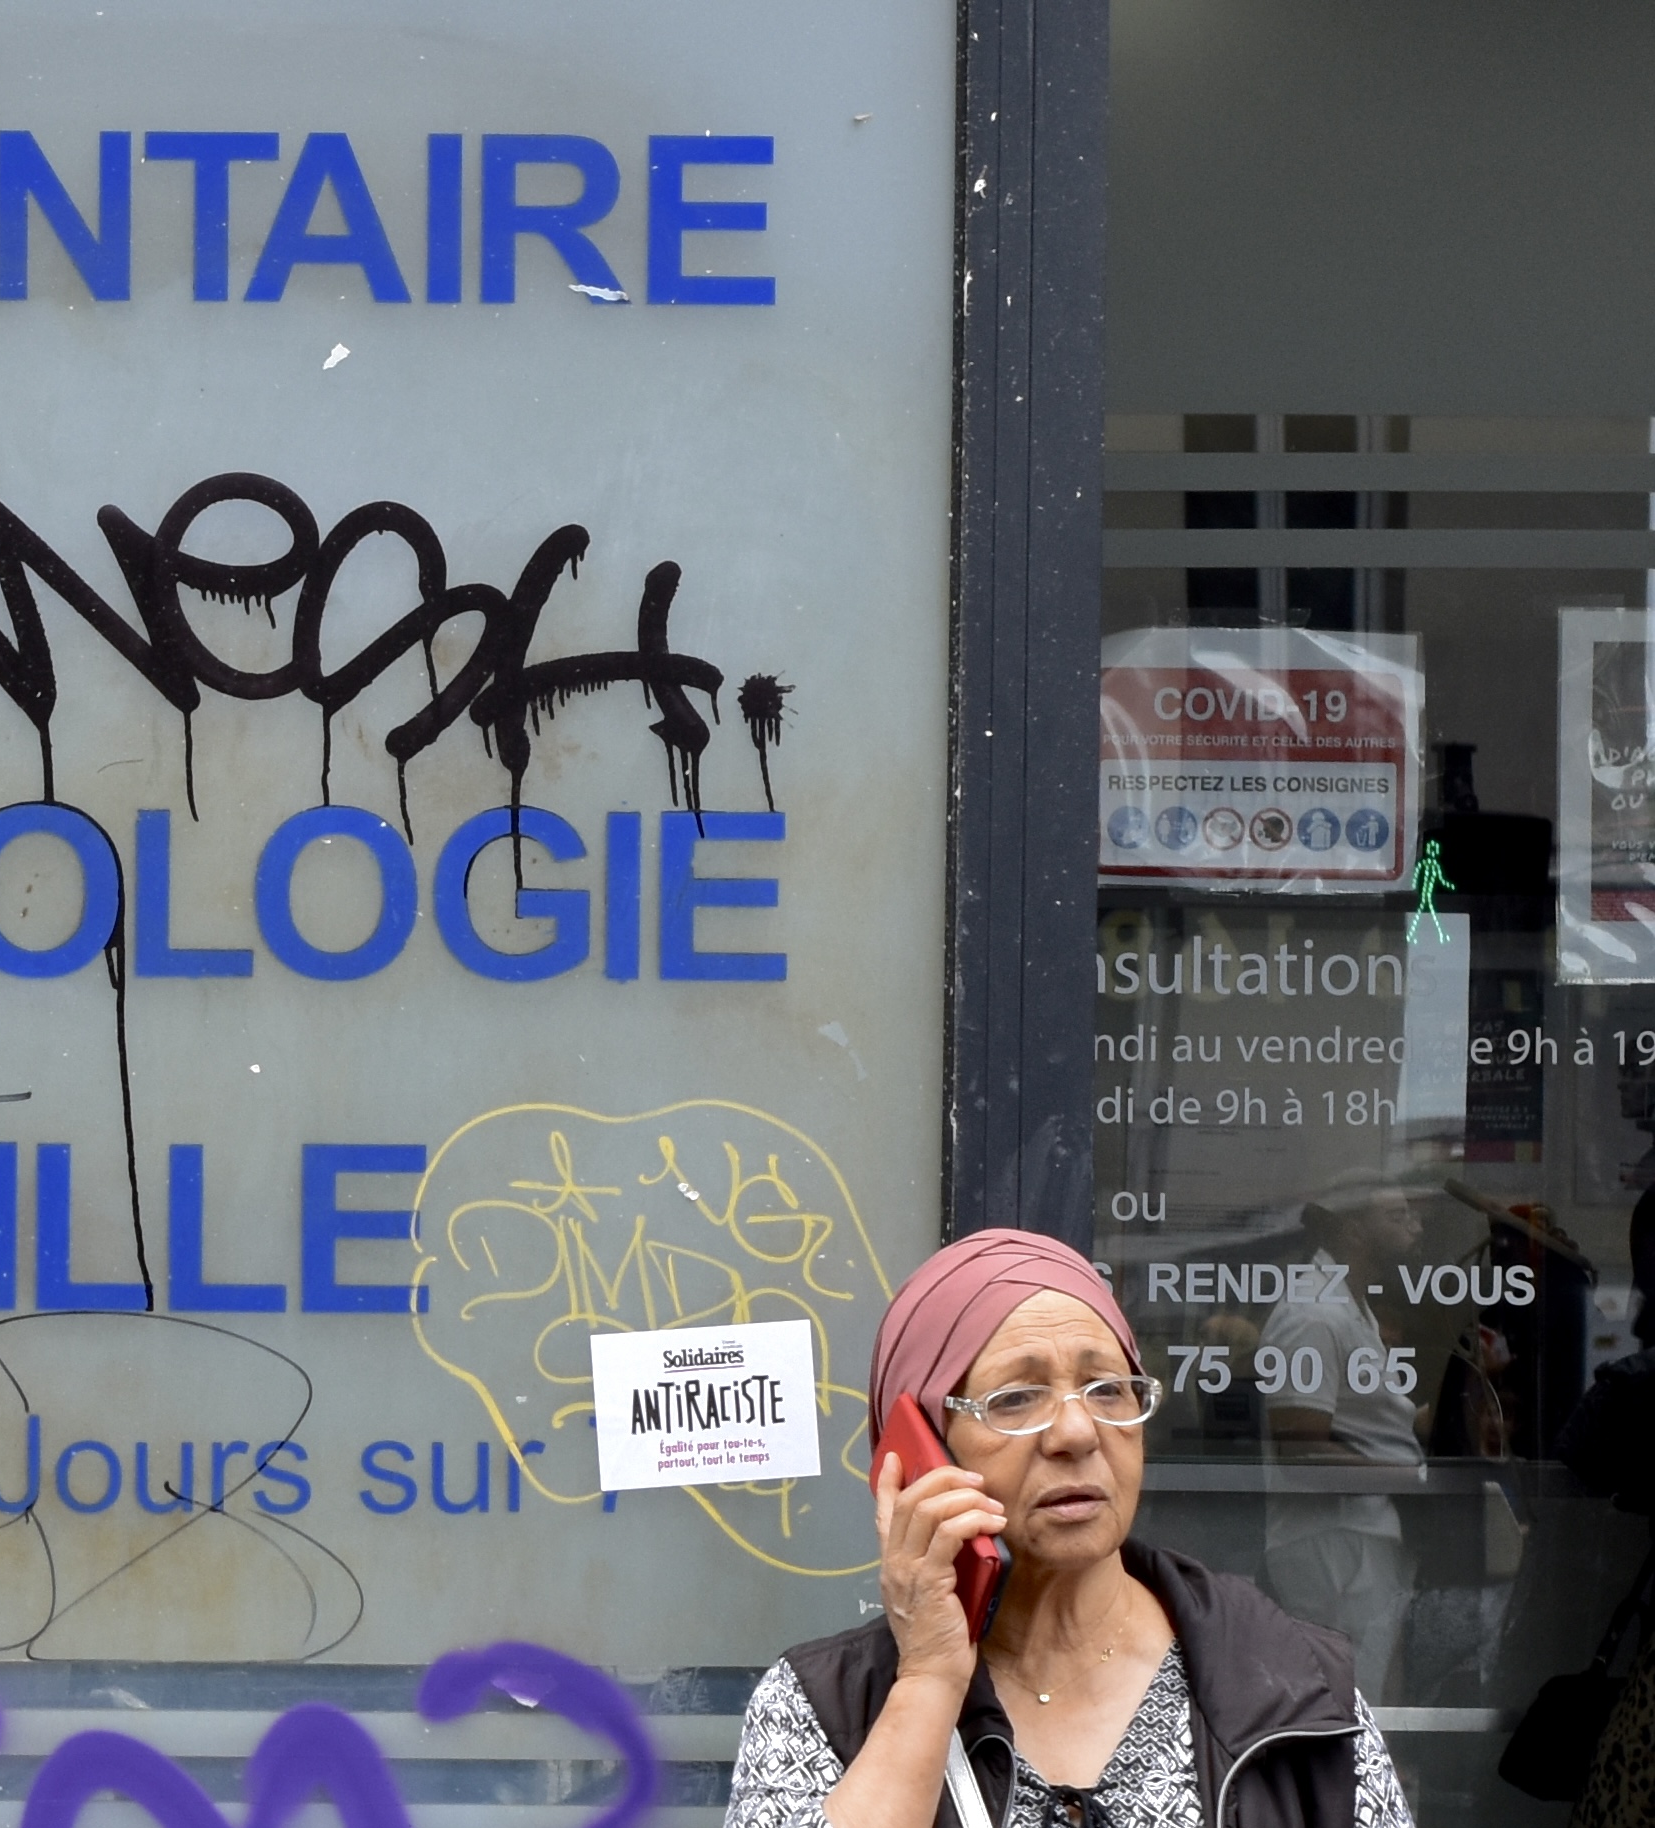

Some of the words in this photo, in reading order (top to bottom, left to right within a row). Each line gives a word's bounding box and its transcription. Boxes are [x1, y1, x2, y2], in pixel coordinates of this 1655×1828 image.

[1154, 687, 1348, 723] COVID-19
[1103, 734, 1139, 746] POUR
[1141, 733, 1183, 746] VOTRE
[1187, 732, 1249, 747] SÉCURITÉ
[1252, 735, 1267, 747] ET
[1272, 735, 1309, 747] CELLE
[1316, 736, 1342, 748] DES
[1345, 737, 1397, 749] AUTRES
[1108, 775, 1224, 791] RESPECTEZ
[1230, 776, 1267, 792] LES
[1273, 776, 1390, 794] CONSIGNES
[1093, 1024, 1158, 1063] ndi
[1172, 1034, 1223, 1064] au
[1507, 1027, 1558, 1066] 9h
[1572, 1026, 1595, 1066] à
[1096, 1086, 1135, 1125] di
[1149, 1086, 1202, 1125] de
[1216, 1087, 1268, 1126] 9h
[1281, 1087, 1305, 1126] à
[1323, 1087, 1396, 1127] 18h
[1111, 1191, 1166, 1222] ou
[1148, 1263, 1351, 1304] RENDEZ
[1398, 1264, 1536, 1306] VOUS
[663, 1346, 745, 1369] Solidaires
[1167, 1346, 1232, 1394] 75
[1254, 1346, 1325, 1395] 90
[1347, 1346, 1418, 1395] 65
[697, 1440, 720, 1455] pour
[702, 1454, 723, 1466] tout
[726, 1451, 736, 1464] le
[739, 1452, 770, 1465] temps
[360, 1440, 545, 1515] sur
